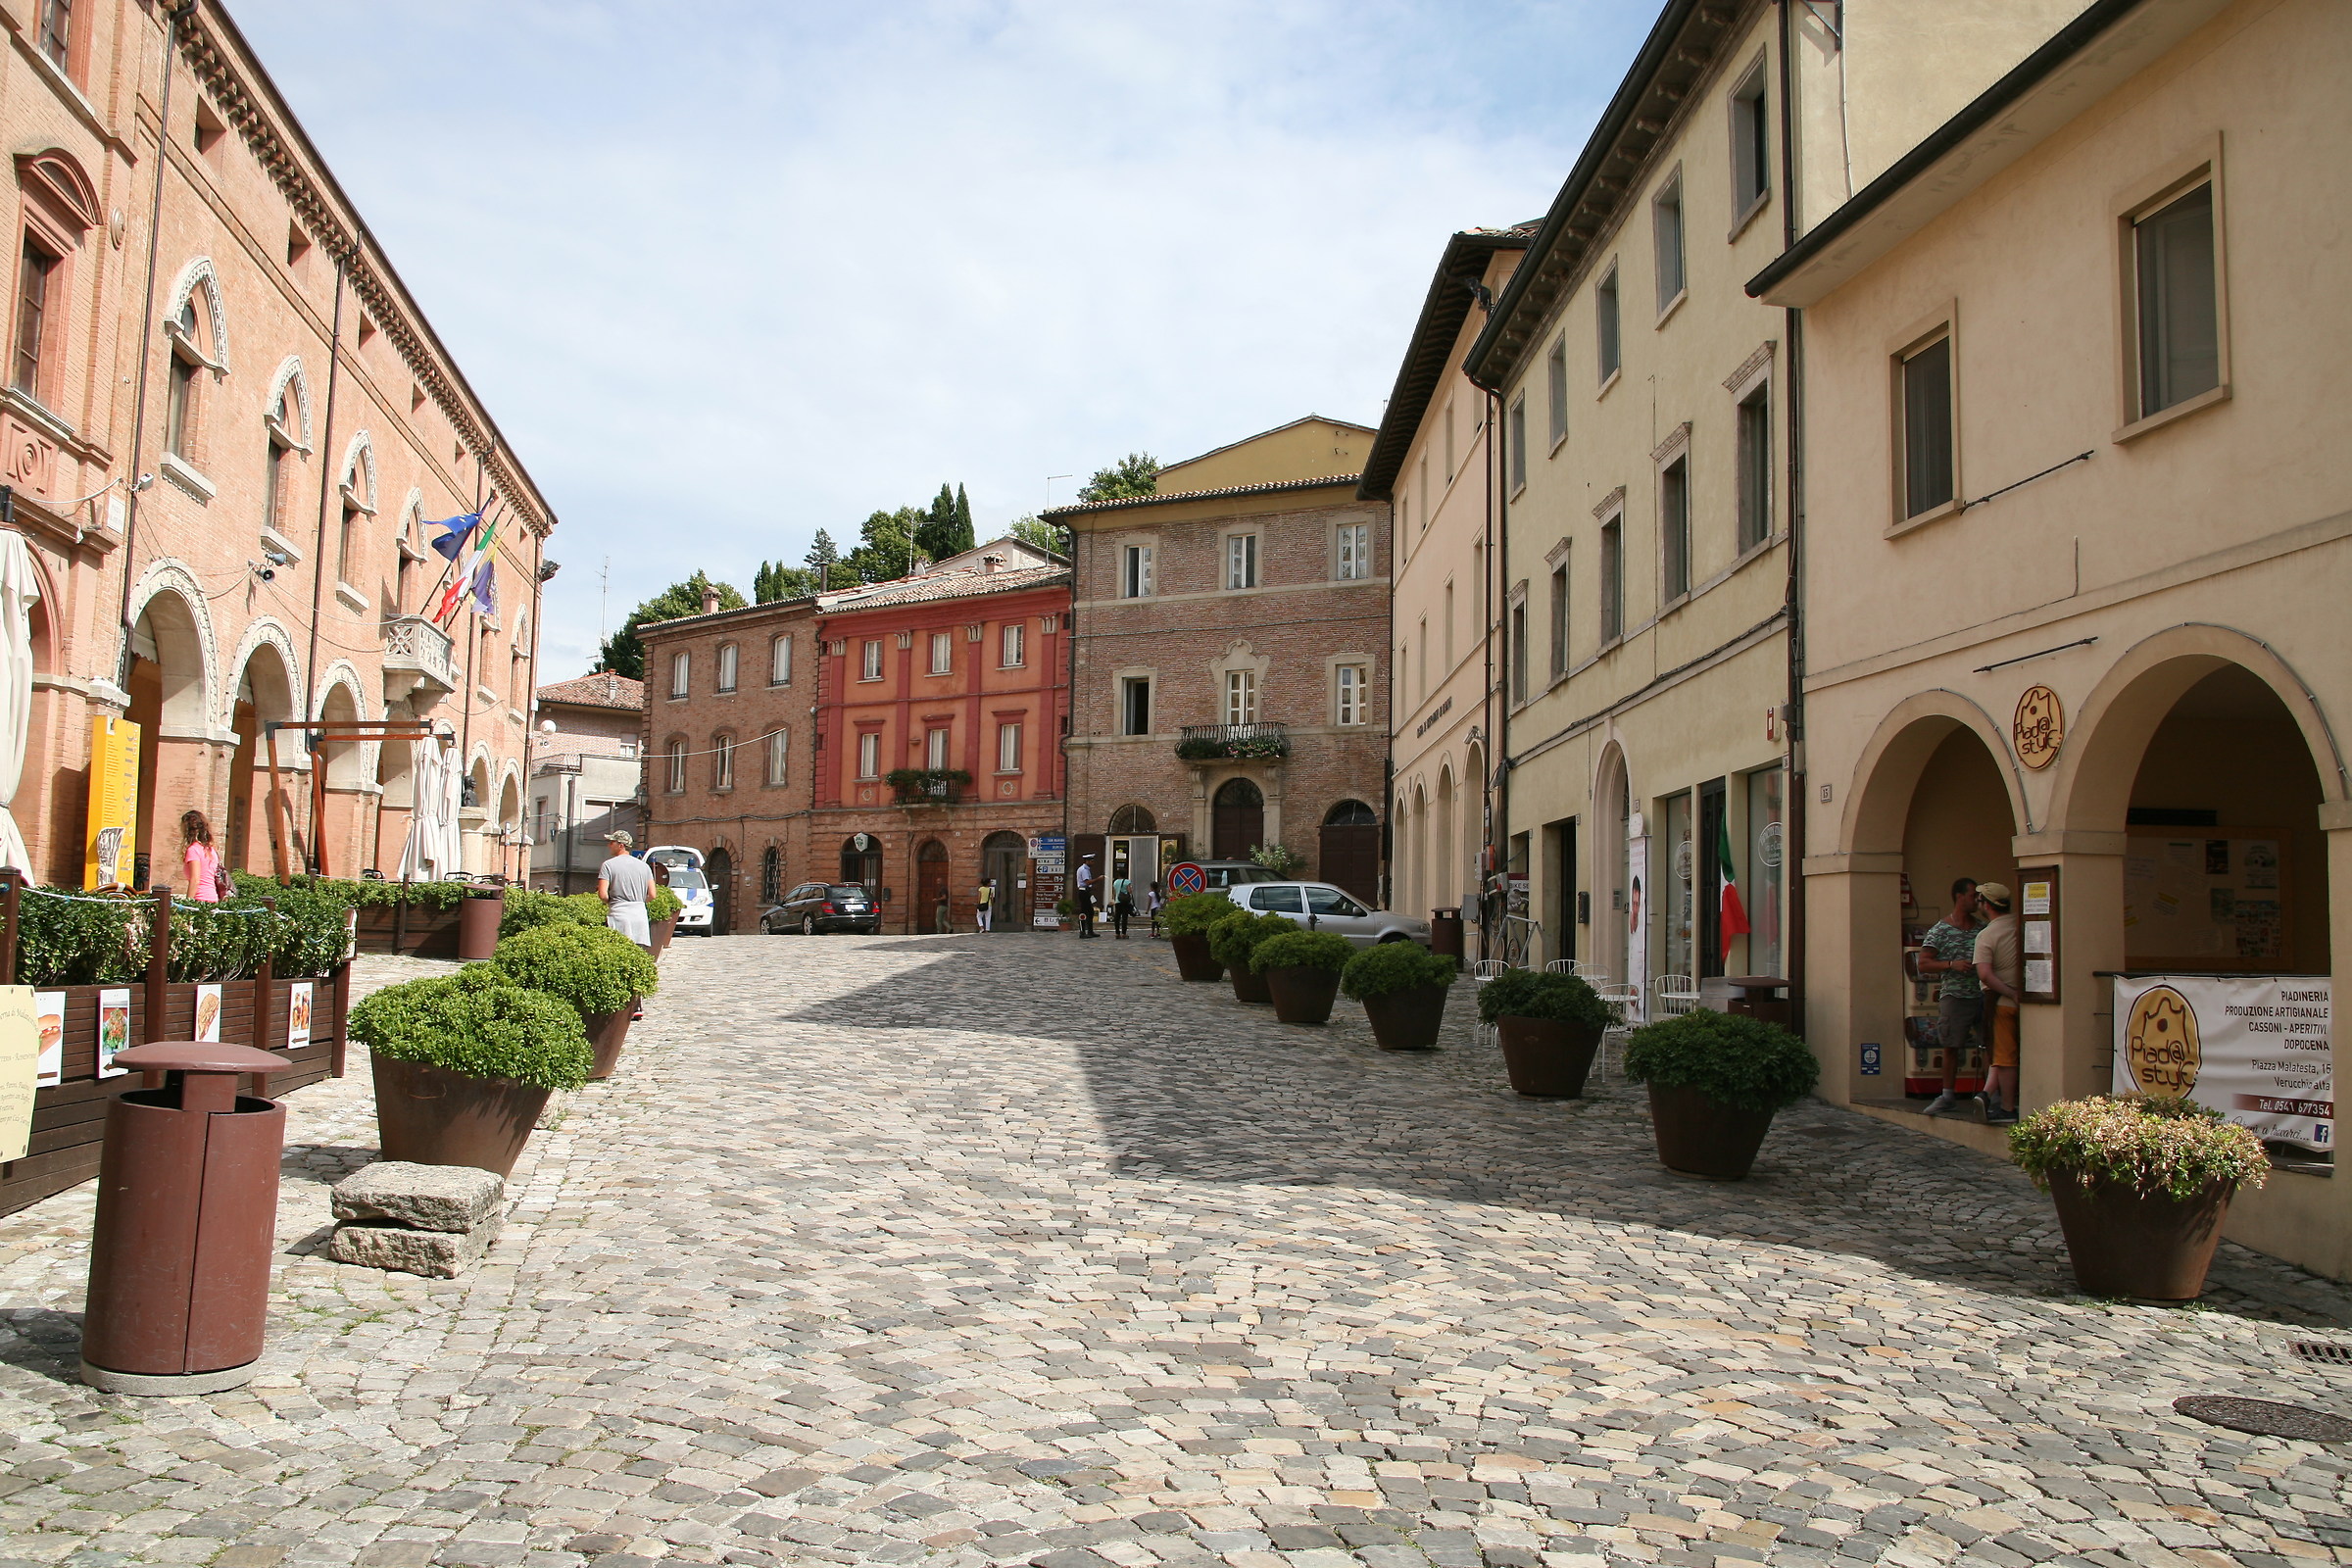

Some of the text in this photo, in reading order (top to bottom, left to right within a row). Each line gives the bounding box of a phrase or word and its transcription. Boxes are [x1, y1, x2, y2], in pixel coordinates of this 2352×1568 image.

[2280, 991, 2329, 1002] PIADINERIA
[2225, 1005, 2328, 1018] PRODUZIONE ARTIGIANALE
[2248, 1021, 2282, 1033] CASSONI
[2289, 1023, 2327, 1035] APERITIVI
[2283, 1039, 2329, 1051] DOPOCENA
[2251, 1059, 2331, 1075] Piazza Malatesta, 15
[2274, 1076, 2330, 1091] Verucchio alta
[2259, 1099, 2330, 1116] Tel. 0541 677354
